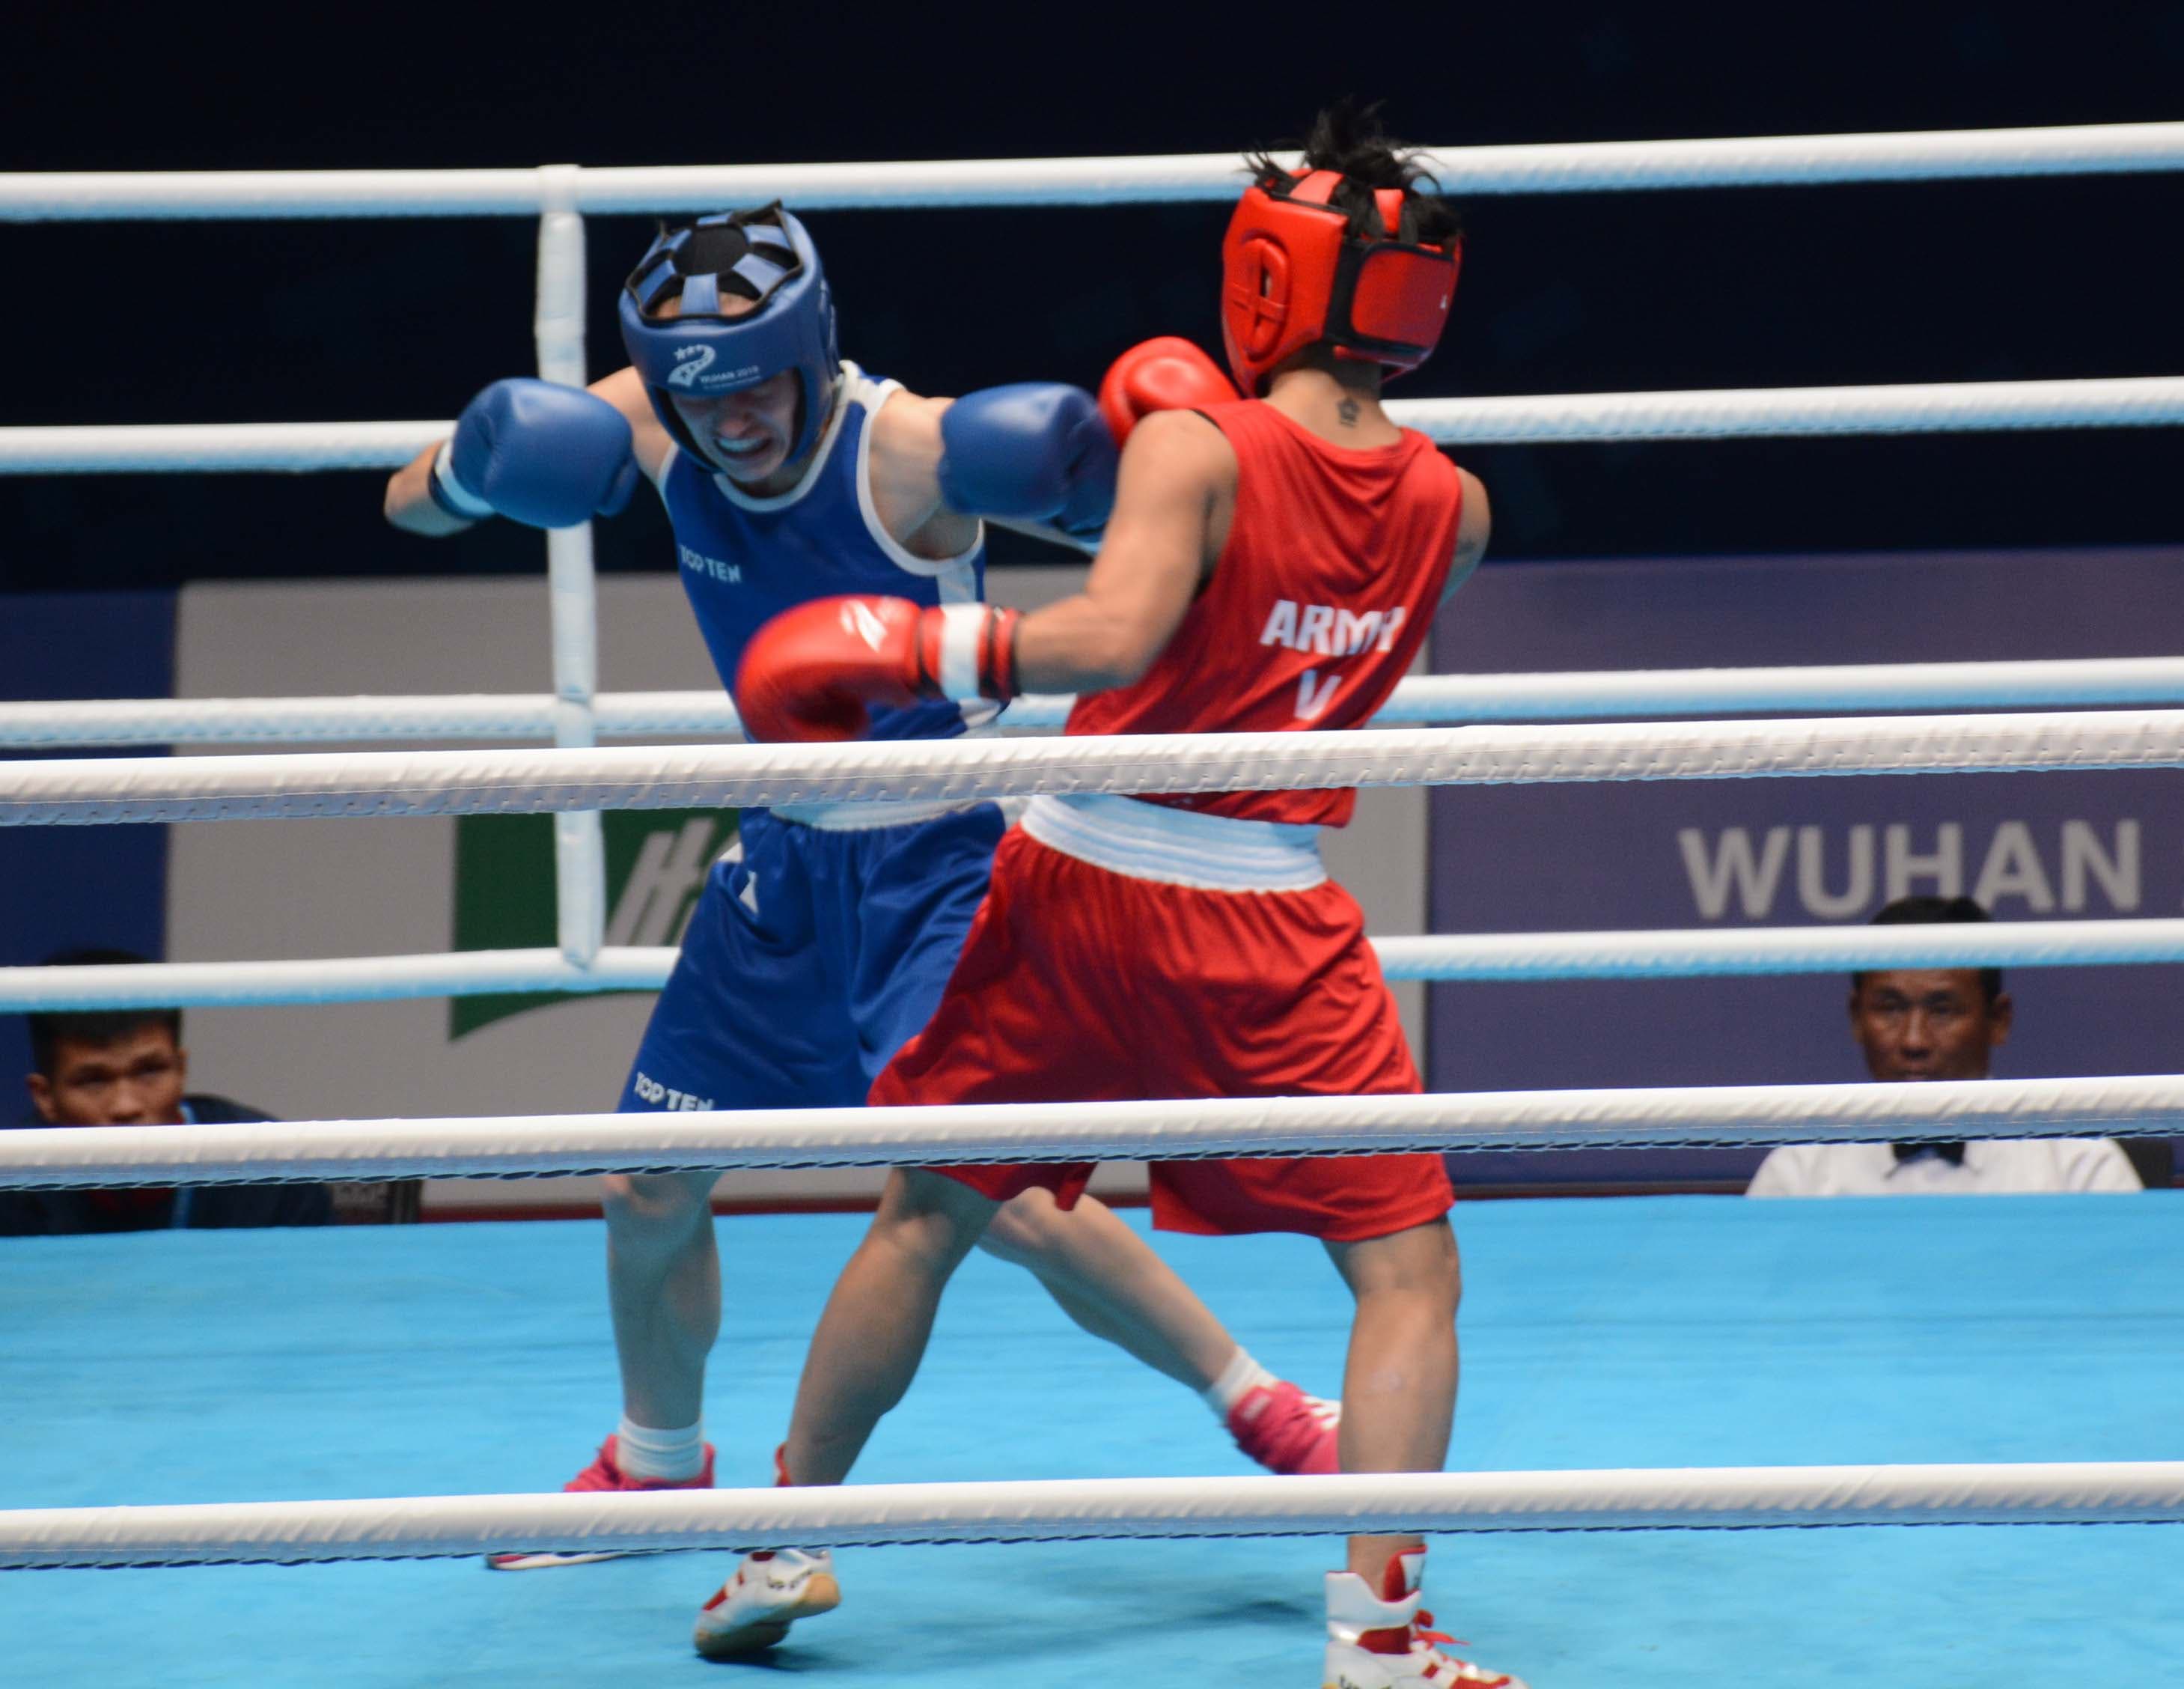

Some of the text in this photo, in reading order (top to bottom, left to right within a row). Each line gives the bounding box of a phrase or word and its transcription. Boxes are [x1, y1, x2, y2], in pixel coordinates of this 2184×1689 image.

[705, 557, 742, 584] TEN
[1678, 818, 2141, 920] WUHAN
[634, 1071, 715, 1111] TOP TEN
